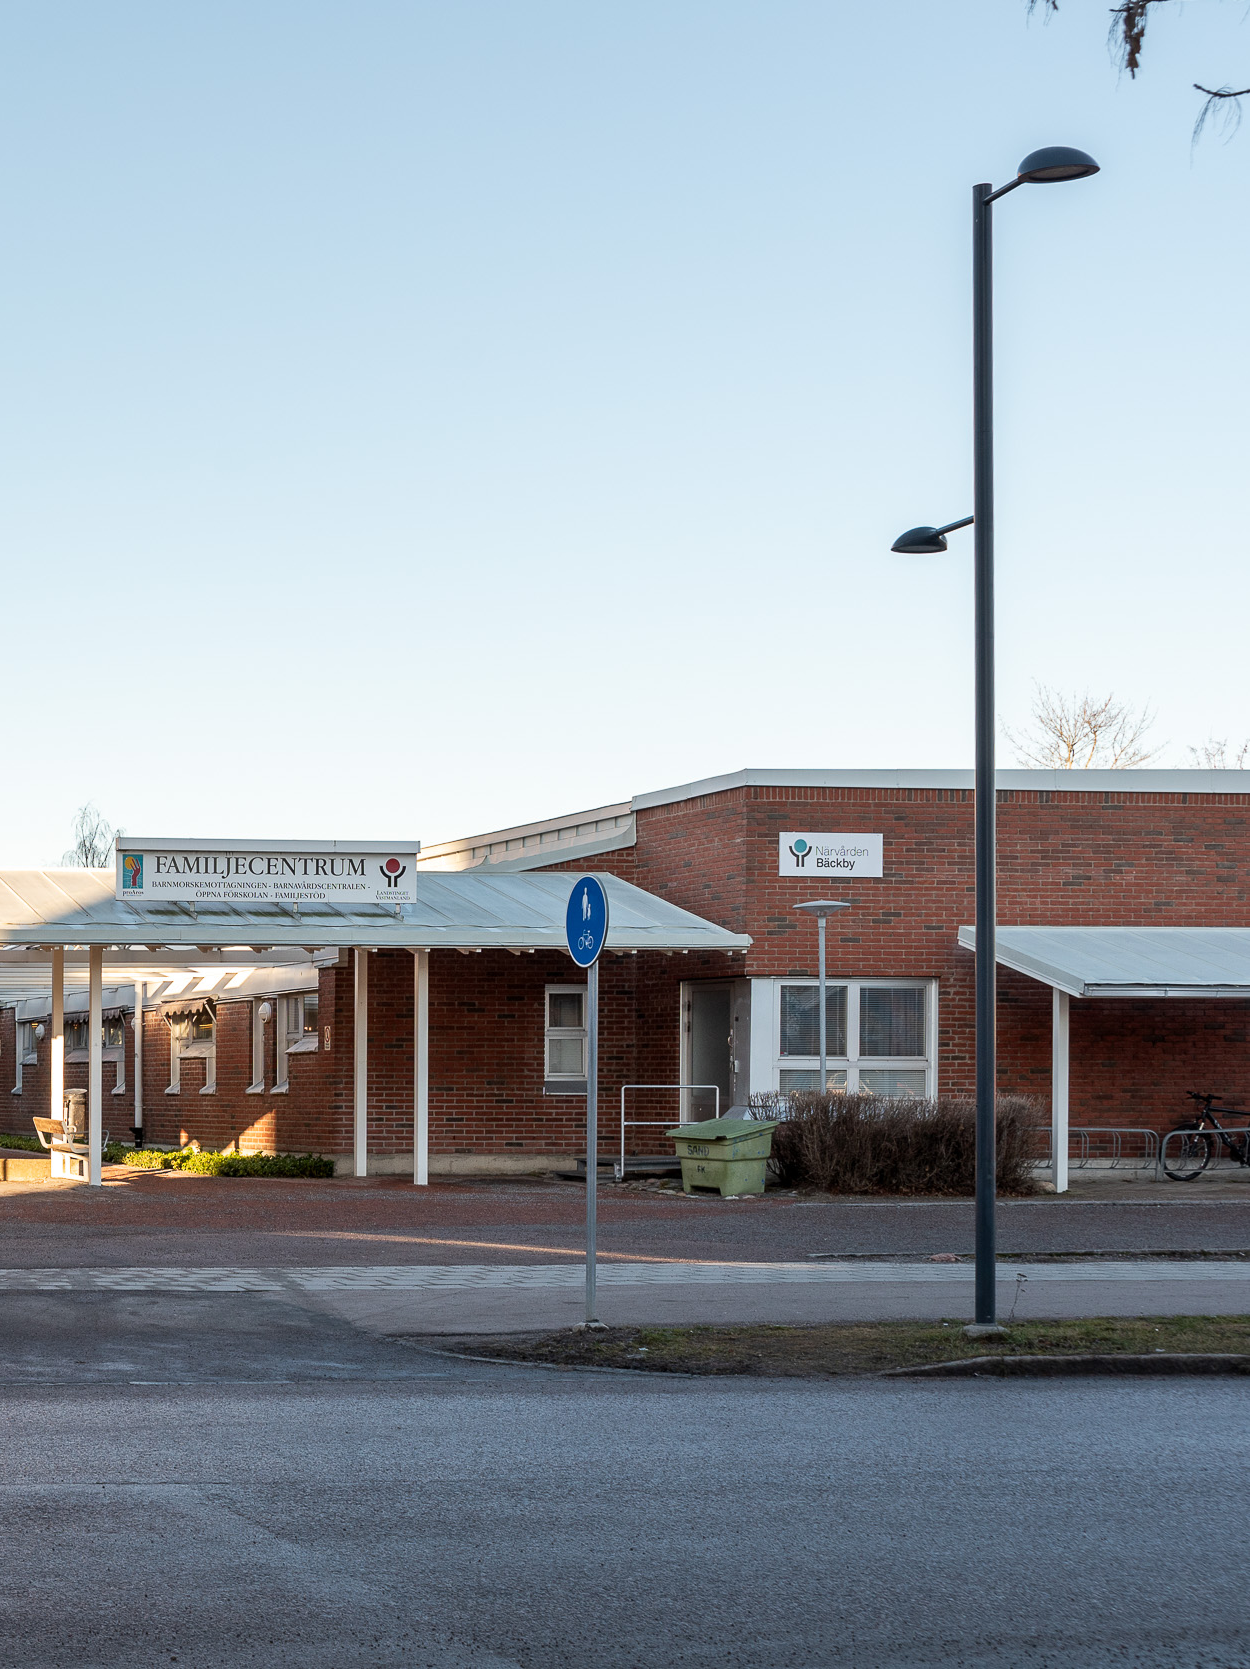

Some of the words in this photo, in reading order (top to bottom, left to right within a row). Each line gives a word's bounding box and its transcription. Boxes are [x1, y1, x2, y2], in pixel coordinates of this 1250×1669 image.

[815, 845, 869, 857] Närvården
[154, 856, 367, 879] FAMILJECENTRUM
[816, 857, 856, 871] Bäckby
[151, 881, 268, 889] BARNMORSKEMOTTAGNINGEN
[273, 881, 366, 890] BARNAVÅRDSCENTRALEN
[195, 890, 222, 898] ÖPPNA
[223, 890, 269, 899] FÖRSKOLAN
[274, 891, 326, 900] FAMILJESTÖD
[687, 1145, 710, 1156] SAND
